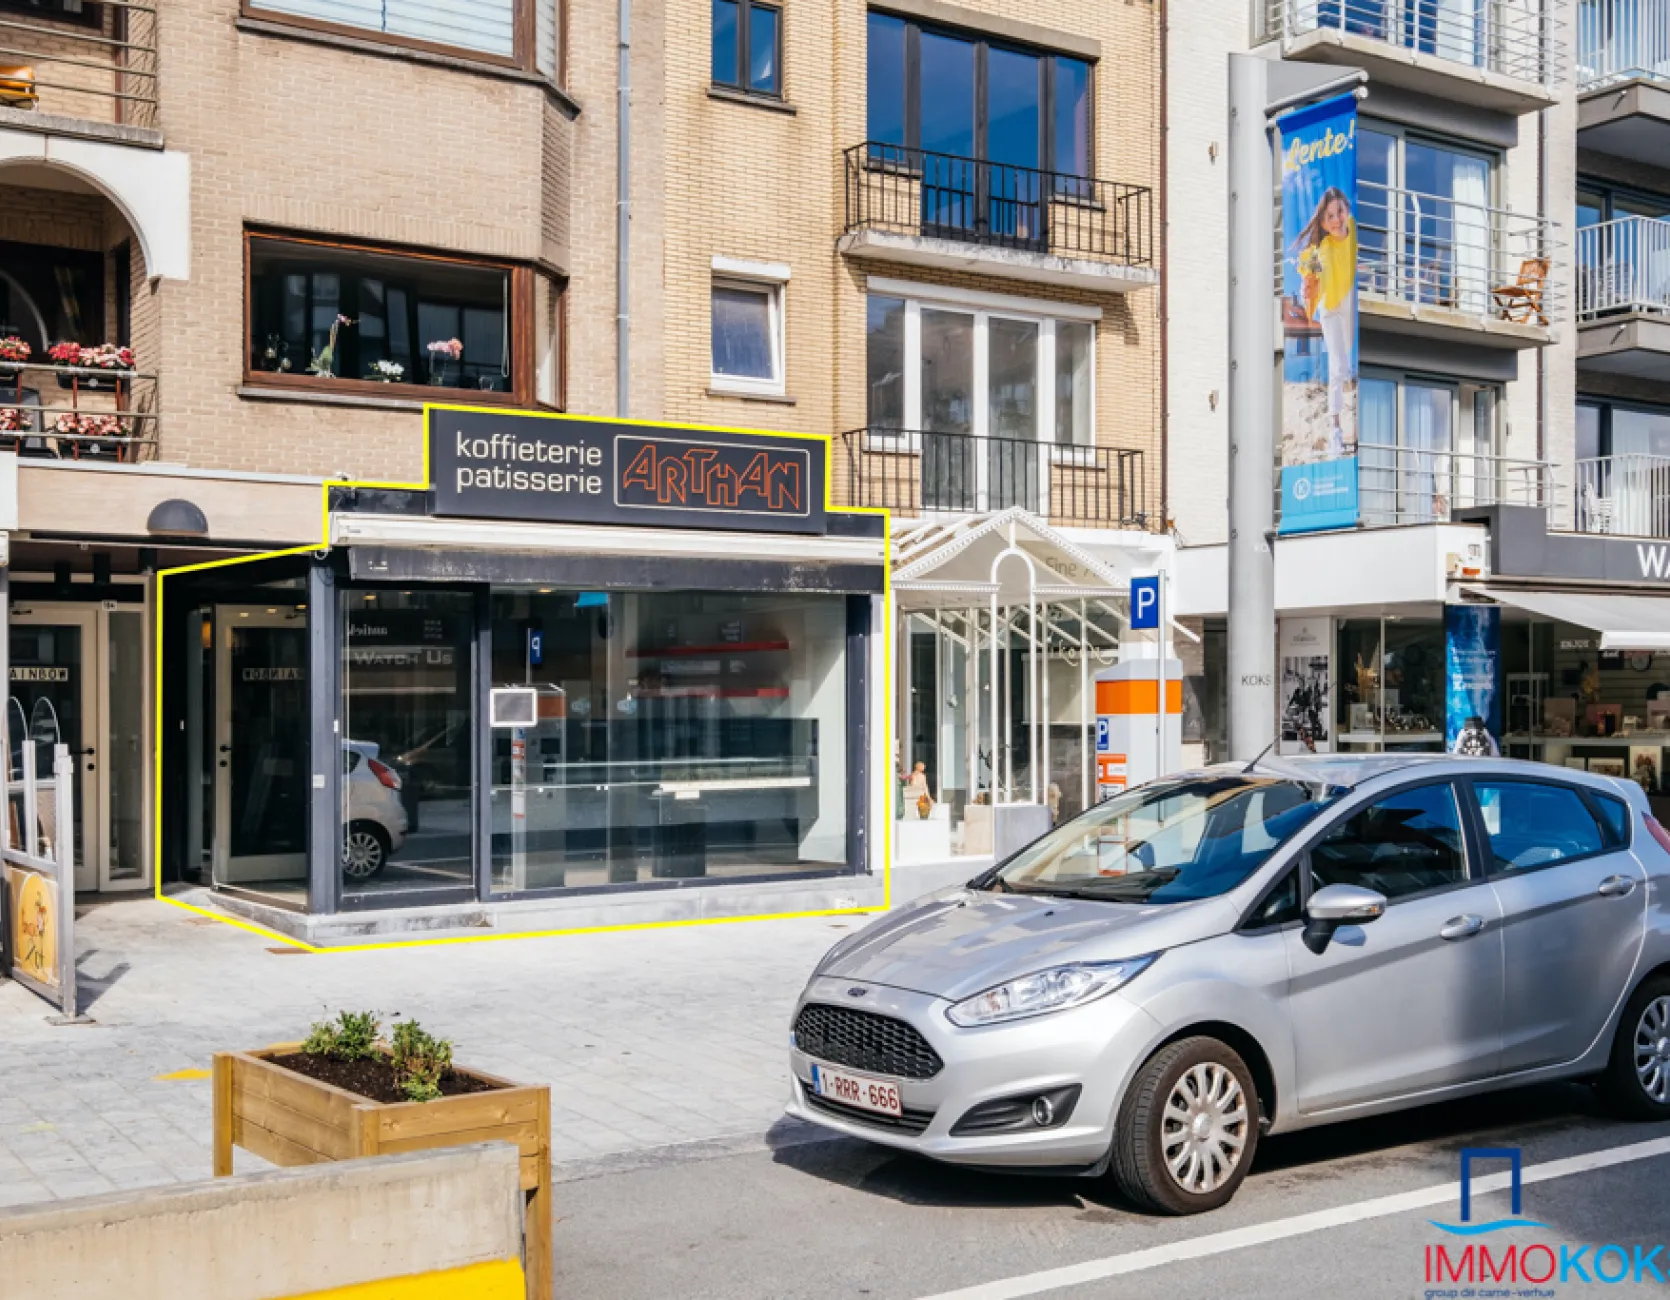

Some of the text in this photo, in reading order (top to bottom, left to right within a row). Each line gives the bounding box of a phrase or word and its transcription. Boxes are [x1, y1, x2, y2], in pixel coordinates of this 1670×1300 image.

[1285, 119, 1355, 171] Lente!
[456, 431, 602, 466] koffieterie
[456, 463, 602, 494] patisserie
[622, 444, 800, 509] ARTHAN
[1138, 587, 1155, 619] P
[9, 668, 67, 681] AINBOW
